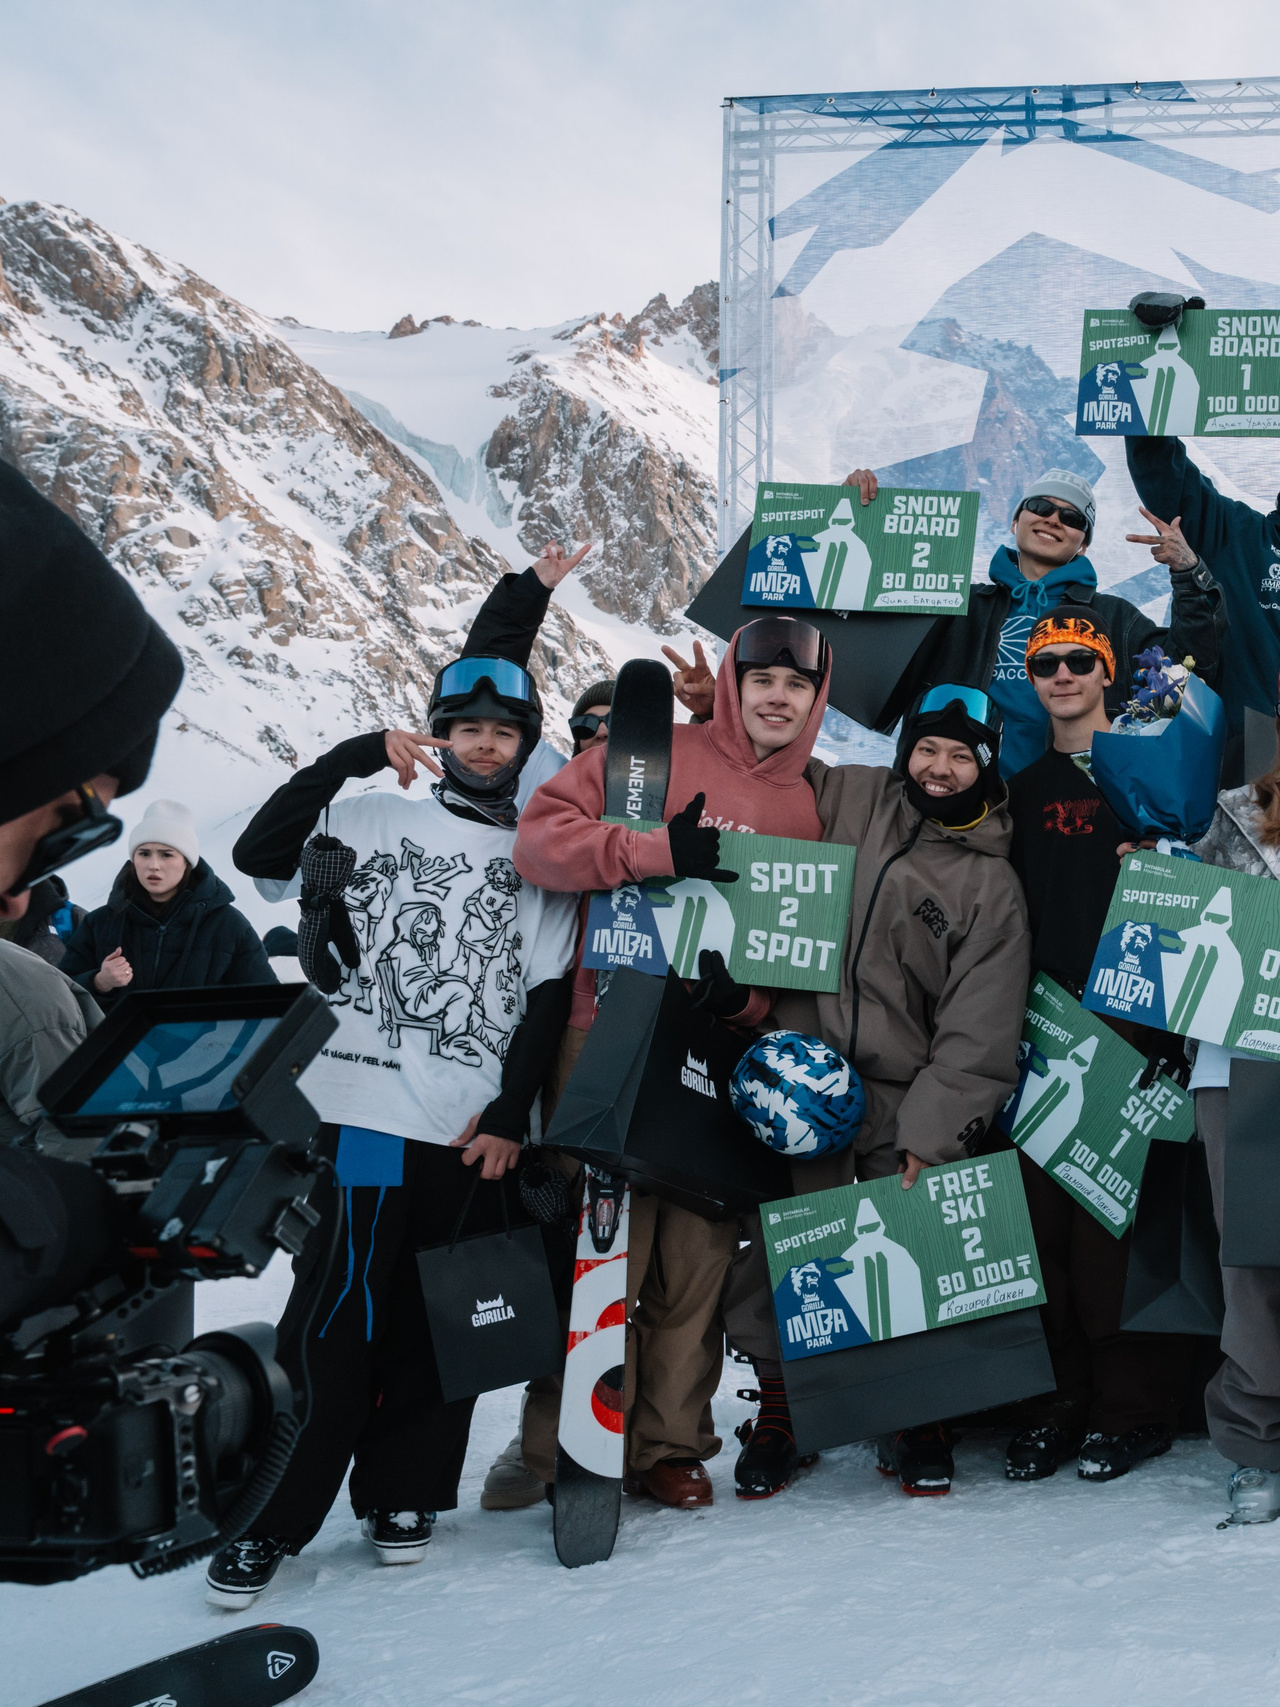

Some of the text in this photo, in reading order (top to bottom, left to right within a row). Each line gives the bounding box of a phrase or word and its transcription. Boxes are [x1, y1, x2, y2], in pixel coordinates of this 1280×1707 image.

[1089, 334, 1151, 351] SPOT2SPOT
[1240, 364, 1251, 391] 1
[1083, 401, 1132, 422] IMBA
[1207, 396, 1237, 413] 100
[1244, 396, 1279, 413] 000
[1095, 421, 1117, 430] PARK
[761, 509, 825, 523] SPOT2SPOT
[893, 496, 961, 516] SNOW
[883, 515, 960, 537] BOARD
[911, 542, 931, 568] 2
[767, 565, 787, 573] GORILLA
[750, 572, 800, 595] IMBA
[882, 572, 906, 589] 80
[913, 574, 949, 590] 000
[762, 592, 785, 601] PARK
[750, 862, 838, 894] SPOT
[1122, 889, 1199, 910] SPOT2SPOT
[778, 897, 799, 928] 2
[613, 920, 637, 931] GORILLA
[592, 928, 653, 959] IMBA
[745, 929, 837, 971] SPOT
[607, 954, 634, 966] PARK
[1118, 961, 1142, 975] GORILLA
[1093, 968, 1155, 1008] IMBA
[1106, 997, 1133, 1013] PARK
[1024, 1006, 1074, 1046] POT2SPOT
[330, 1051, 361, 1064] VAGUELY
[362, 1055, 380, 1067] FEEL
[681, 1066, 717, 1099] GORILLA
[1120, 1096, 1160, 1136] SKI
[1108, 1127, 1132, 1159] 1
[1068, 1138, 1100, 1173] 100
[1097, 1165, 1132, 1201] 000
[926, 1163, 993, 1202] FREE
[941, 1193, 986, 1225] SKI
[774, 1218, 847, 1254] SPOT2SPOT
[961, 1226, 985, 1261] 2
[937, 1271, 966, 1297] 80
[972, 1258, 1015, 1288] 000
[471, 1305, 516, 1328] GORILLA
[801, 1300, 825, 1313] GORILLA
[786, 1308, 848, 1343] IMBA
[806, 1335, 833, 1350] PARK
